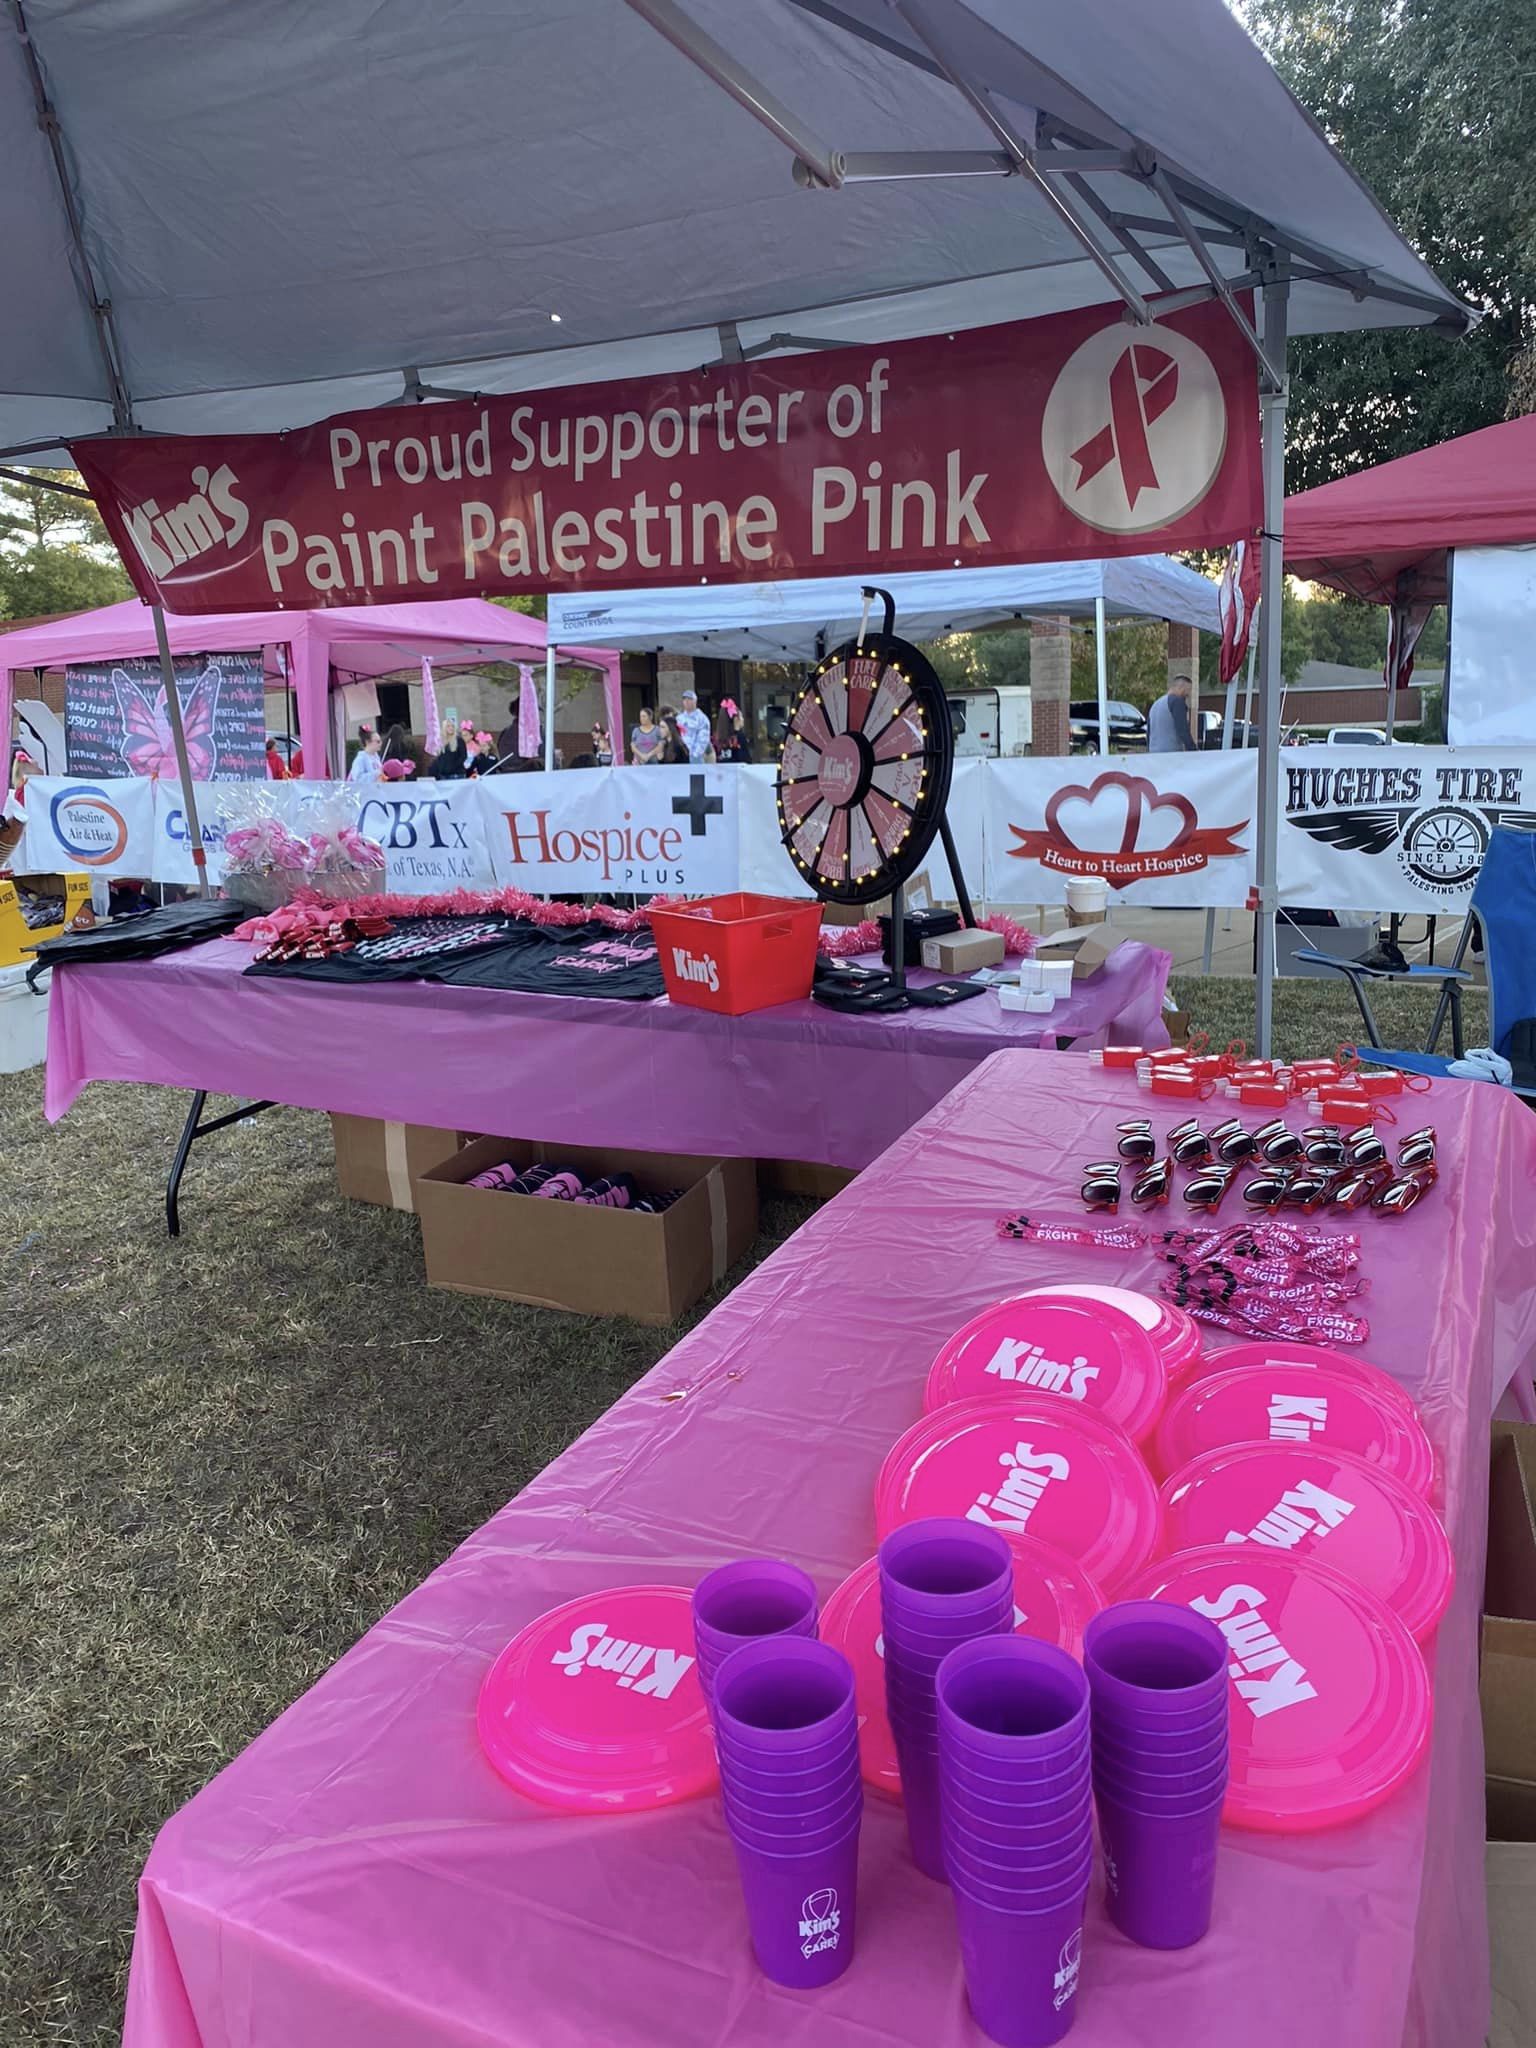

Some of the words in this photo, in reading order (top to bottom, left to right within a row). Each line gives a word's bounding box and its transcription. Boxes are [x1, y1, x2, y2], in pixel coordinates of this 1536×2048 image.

[329, 408, 492, 491] Proud
[509, 390, 805, 482] Supporter
[826, 357, 891, 438] of
[119, 462, 250, 581] Kim's
[262, 512, 439, 593] Paint
[462, 480, 779, 581] Palestine
[810, 448, 993, 558] Pink
[1285, 767, 1422, 812] HUGHES
[1435, 768, 1524, 805] TIRE
[67, 810, 105, 825] Palestine
[68, 827, 83, 840] Air
[91, 830, 114, 842] Heat
[501, 810, 682, 880] Hospice
[393, 857, 407, 877] of
[407, 857, 443, 878] Texas,
[1043, 848, 1082, 871] Heart
[1086, 859, 1098, 872] to
[1101, 859, 1142, 874] Heart
[1143, 853, 1204, 876] Hospice
[1397, 852, 1444, 864] SINCE
[1458, 854, 1485, 865] 198
[625, 869, 685, 885] PLUS
[671, 947, 720, 993] Kim's
[1036, 1229, 1080, 1241] FIGHT
[1243, 1266, 1289, 1286] FIGHT
[1268, 1283, 1316, 1299] FIGHT
[1307, 1316, 1358, 1332] FIGHT
[983, 1336, 1100, 1402] Kim's
[965, 1440, 1070, 1533] Kim's
[551, 1622, 697, 1700] Kim's
[1188, 1583, 1319, 1719] Kims
[798, 1909, 841, 1937] Kim's
